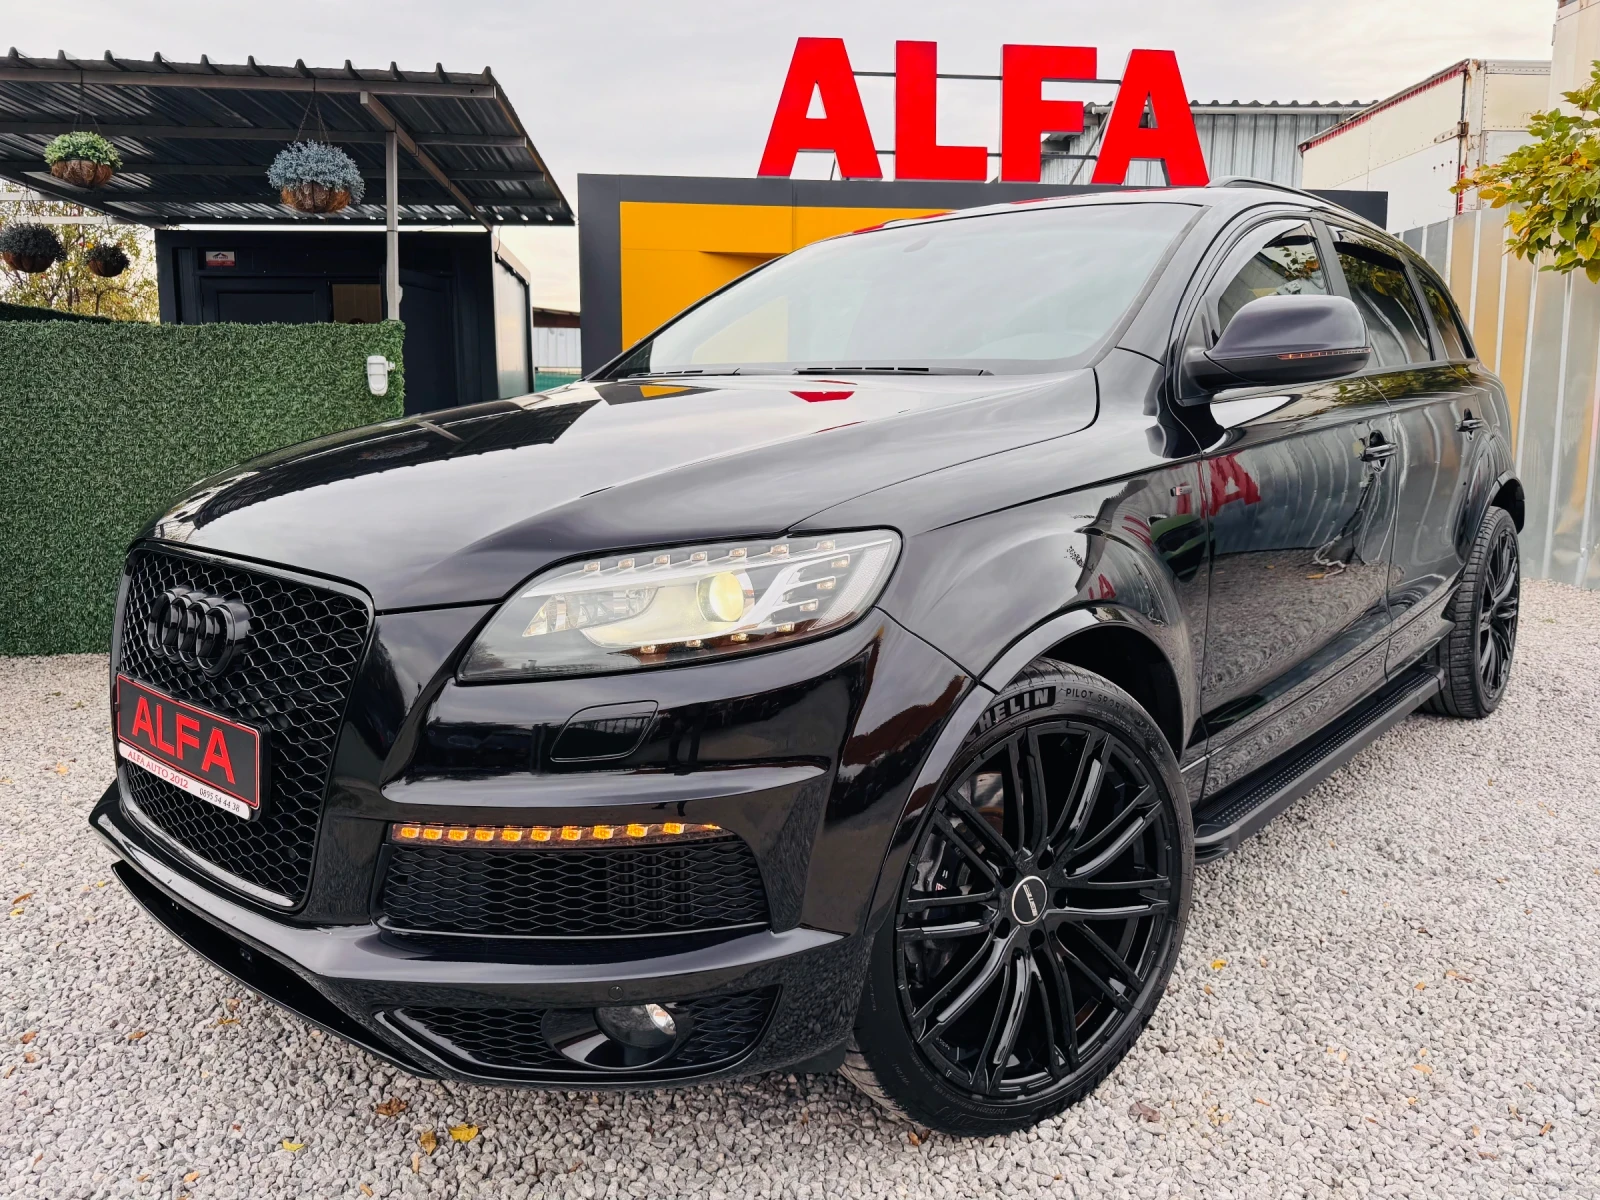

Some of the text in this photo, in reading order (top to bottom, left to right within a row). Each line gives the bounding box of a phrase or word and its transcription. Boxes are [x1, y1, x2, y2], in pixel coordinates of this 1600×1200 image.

[757, 36, 1209, 186] ALFA
[1066, 688, 1126, 713] PILOT SPORT
[132, 695, 236, 785] ALFA
[127, 750, 189, 789] ALFA AUTO 2012
[200, 787, 240, 812] 0895 54 44 38
